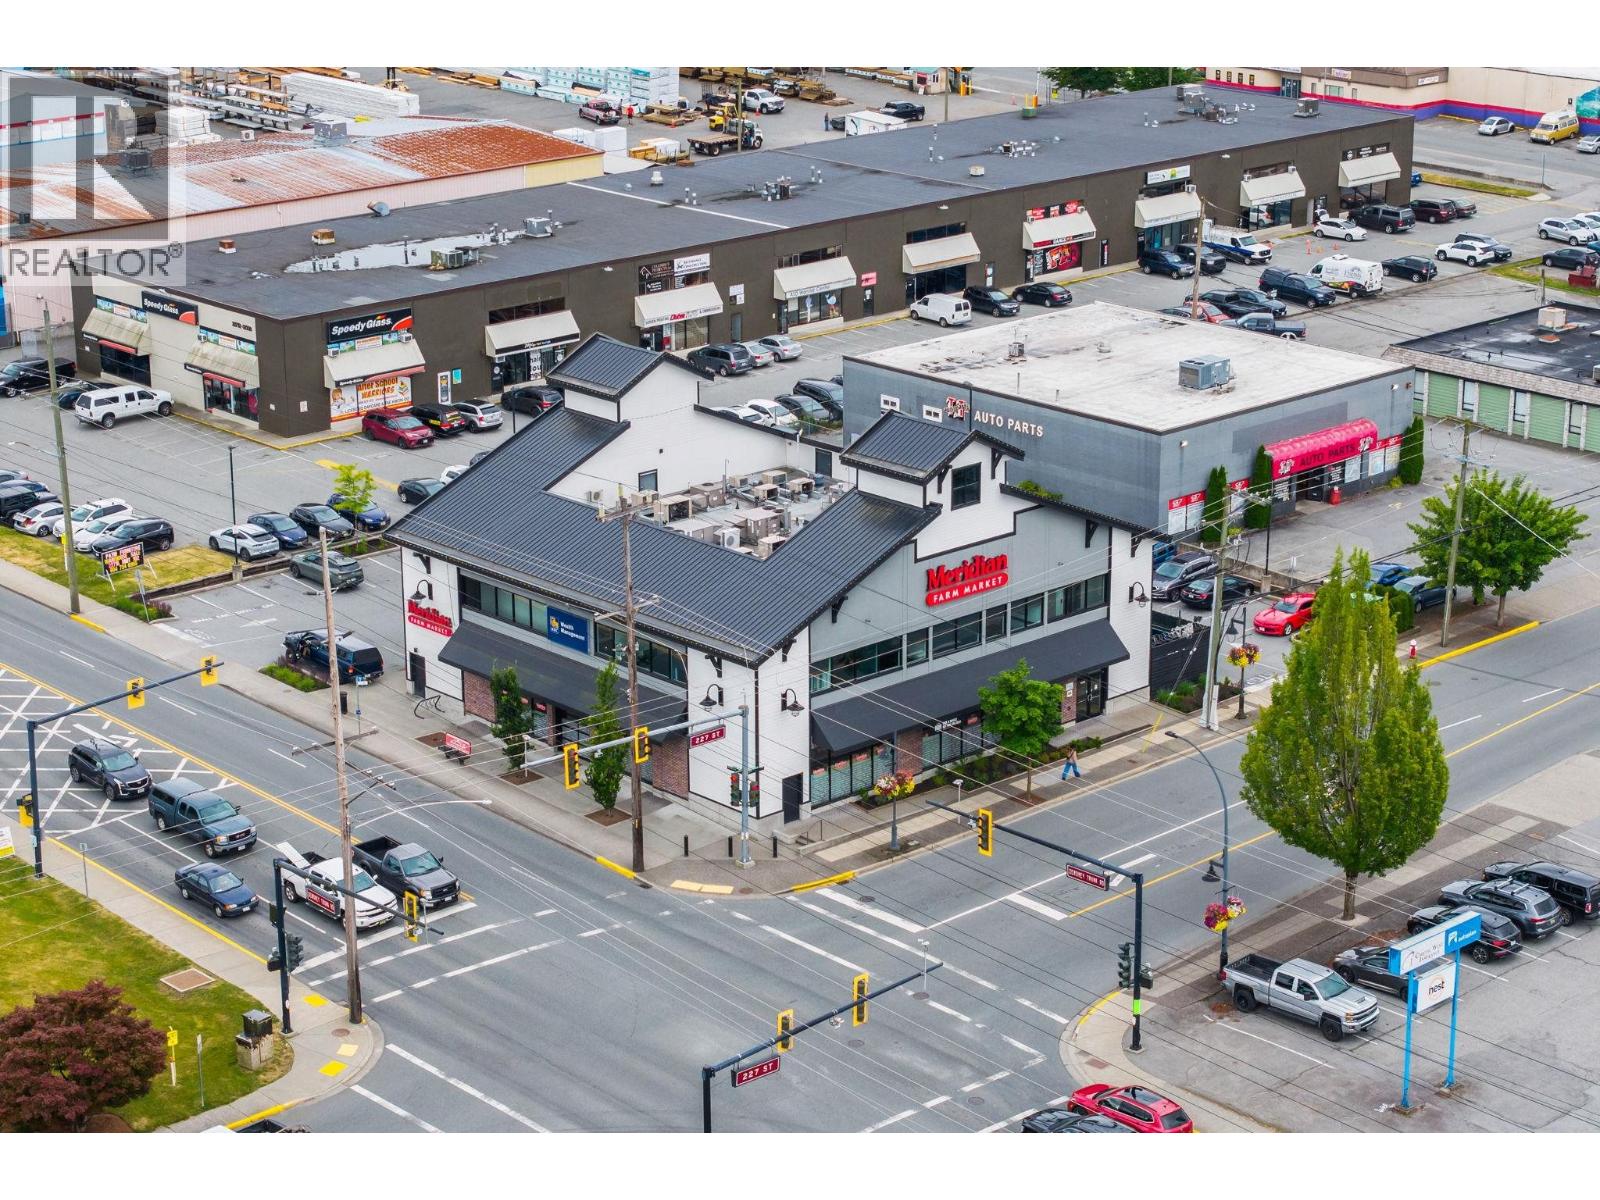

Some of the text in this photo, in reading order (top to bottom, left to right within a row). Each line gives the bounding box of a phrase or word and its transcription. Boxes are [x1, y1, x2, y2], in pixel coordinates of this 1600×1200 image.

[974, 410, 1044, 437] AUTO PARTS
[1301, 444, 1356, 466] AUTO PARTS
[926, 554, 1008, 592] Meridian
[933, 576, 1003, 604] FARM MARKET
[695, 731, 721, 744] 227 ST
[1428, 980, 1445, 995] nest
[742, 1062, 774, 1080] 227 ST
